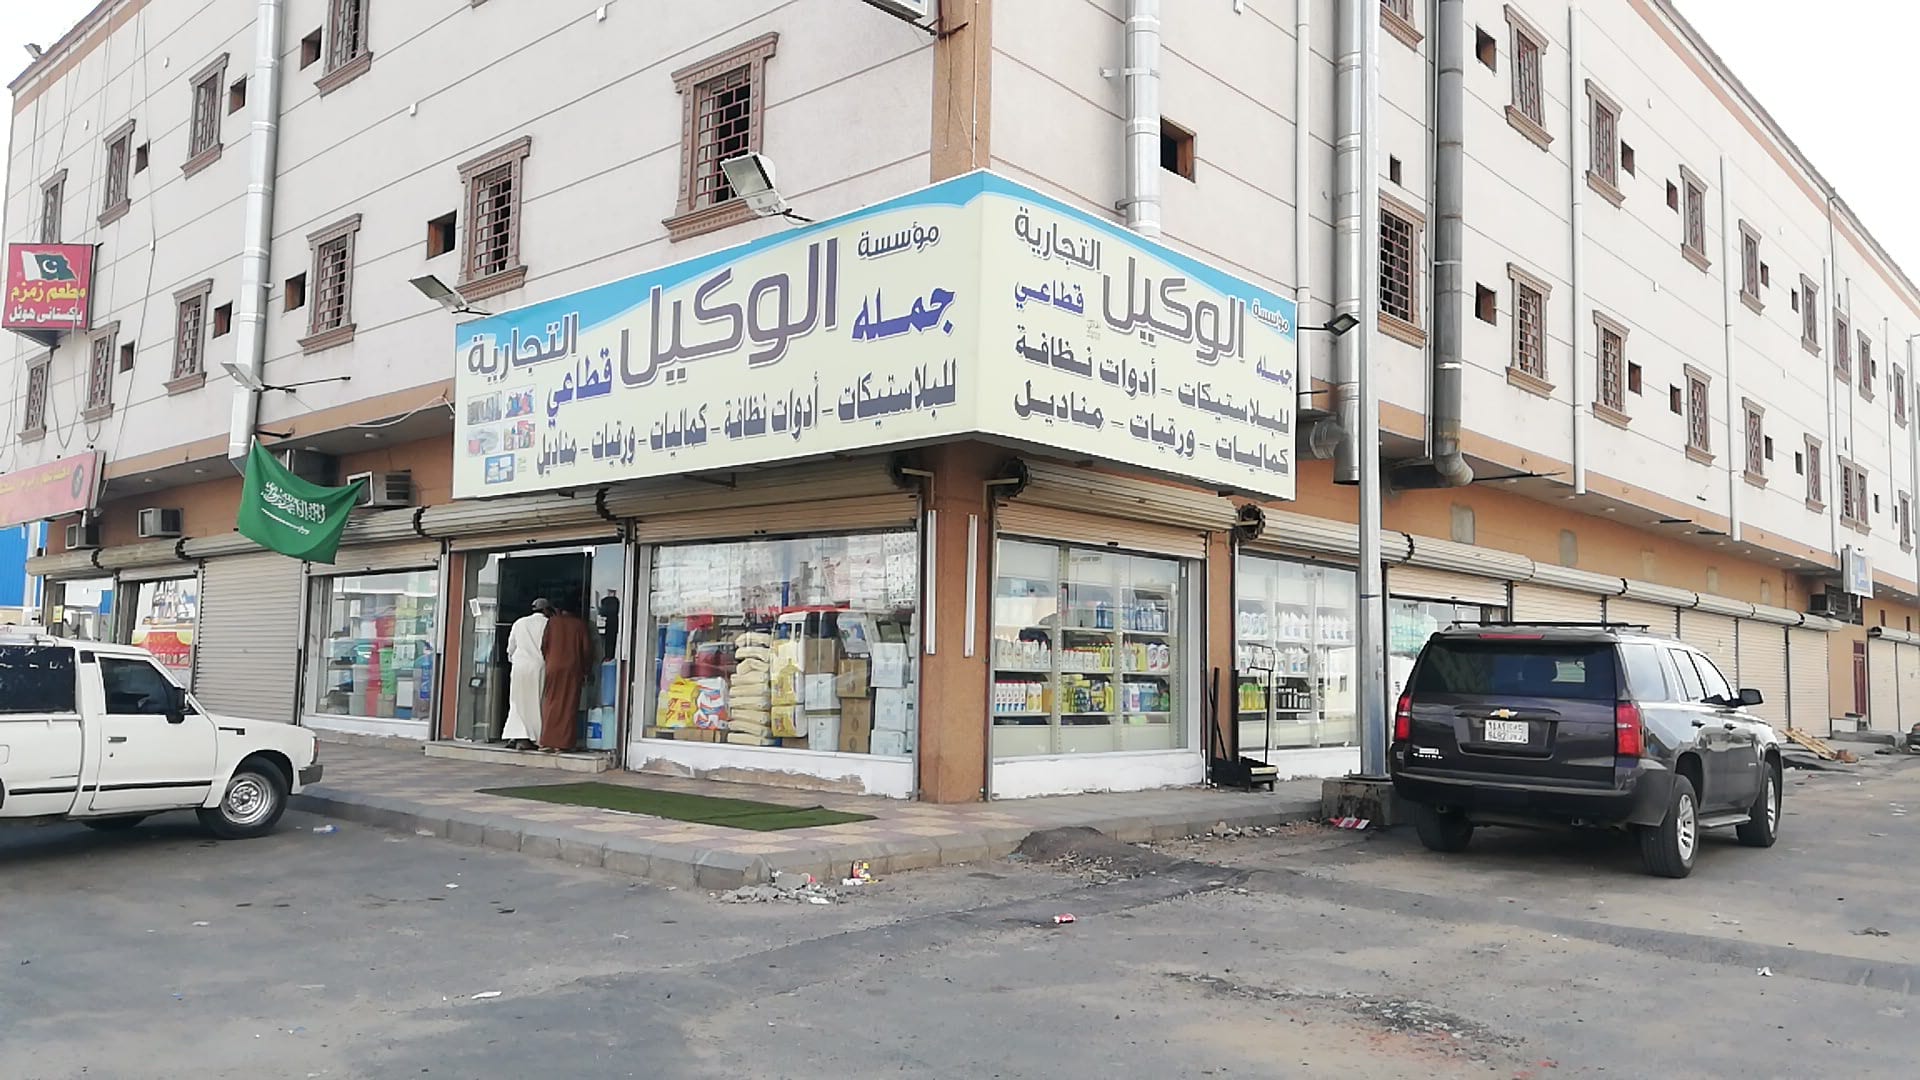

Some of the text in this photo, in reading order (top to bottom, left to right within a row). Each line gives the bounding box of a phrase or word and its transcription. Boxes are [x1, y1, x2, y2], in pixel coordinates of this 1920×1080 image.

[1015, 207, 1101, 270] التجارية
[11, 282, 86, 303] مطعم زمزم
[467, 221, 939, 386] مؤسسة الوكيل التجارية
[1015, 280, 1084, 314] قطاعي
[1103, 256, 1244, 361] الوكيل
[1015, 324, 1092, 377] نظافة
[1099, 358, 1156, 396] أدوات
[546, 347, 613, 428] قطاعي
[771, 372, 819, 441] أدوات
[838, 358, 956, 429] للبلاستيكات
[1014, 380, 1104, 429] مناديل
[1178, 382, 1289, 437] للبلاستيكات
[591, 421, 635, 466] ورقيات
[650, 403, 708, 457] كماليات
[724, 394, 767, 440] نظافة
[1130, 413, 1195, 457] ورقيات
[1216, 436, 1289, 474] كماليات
